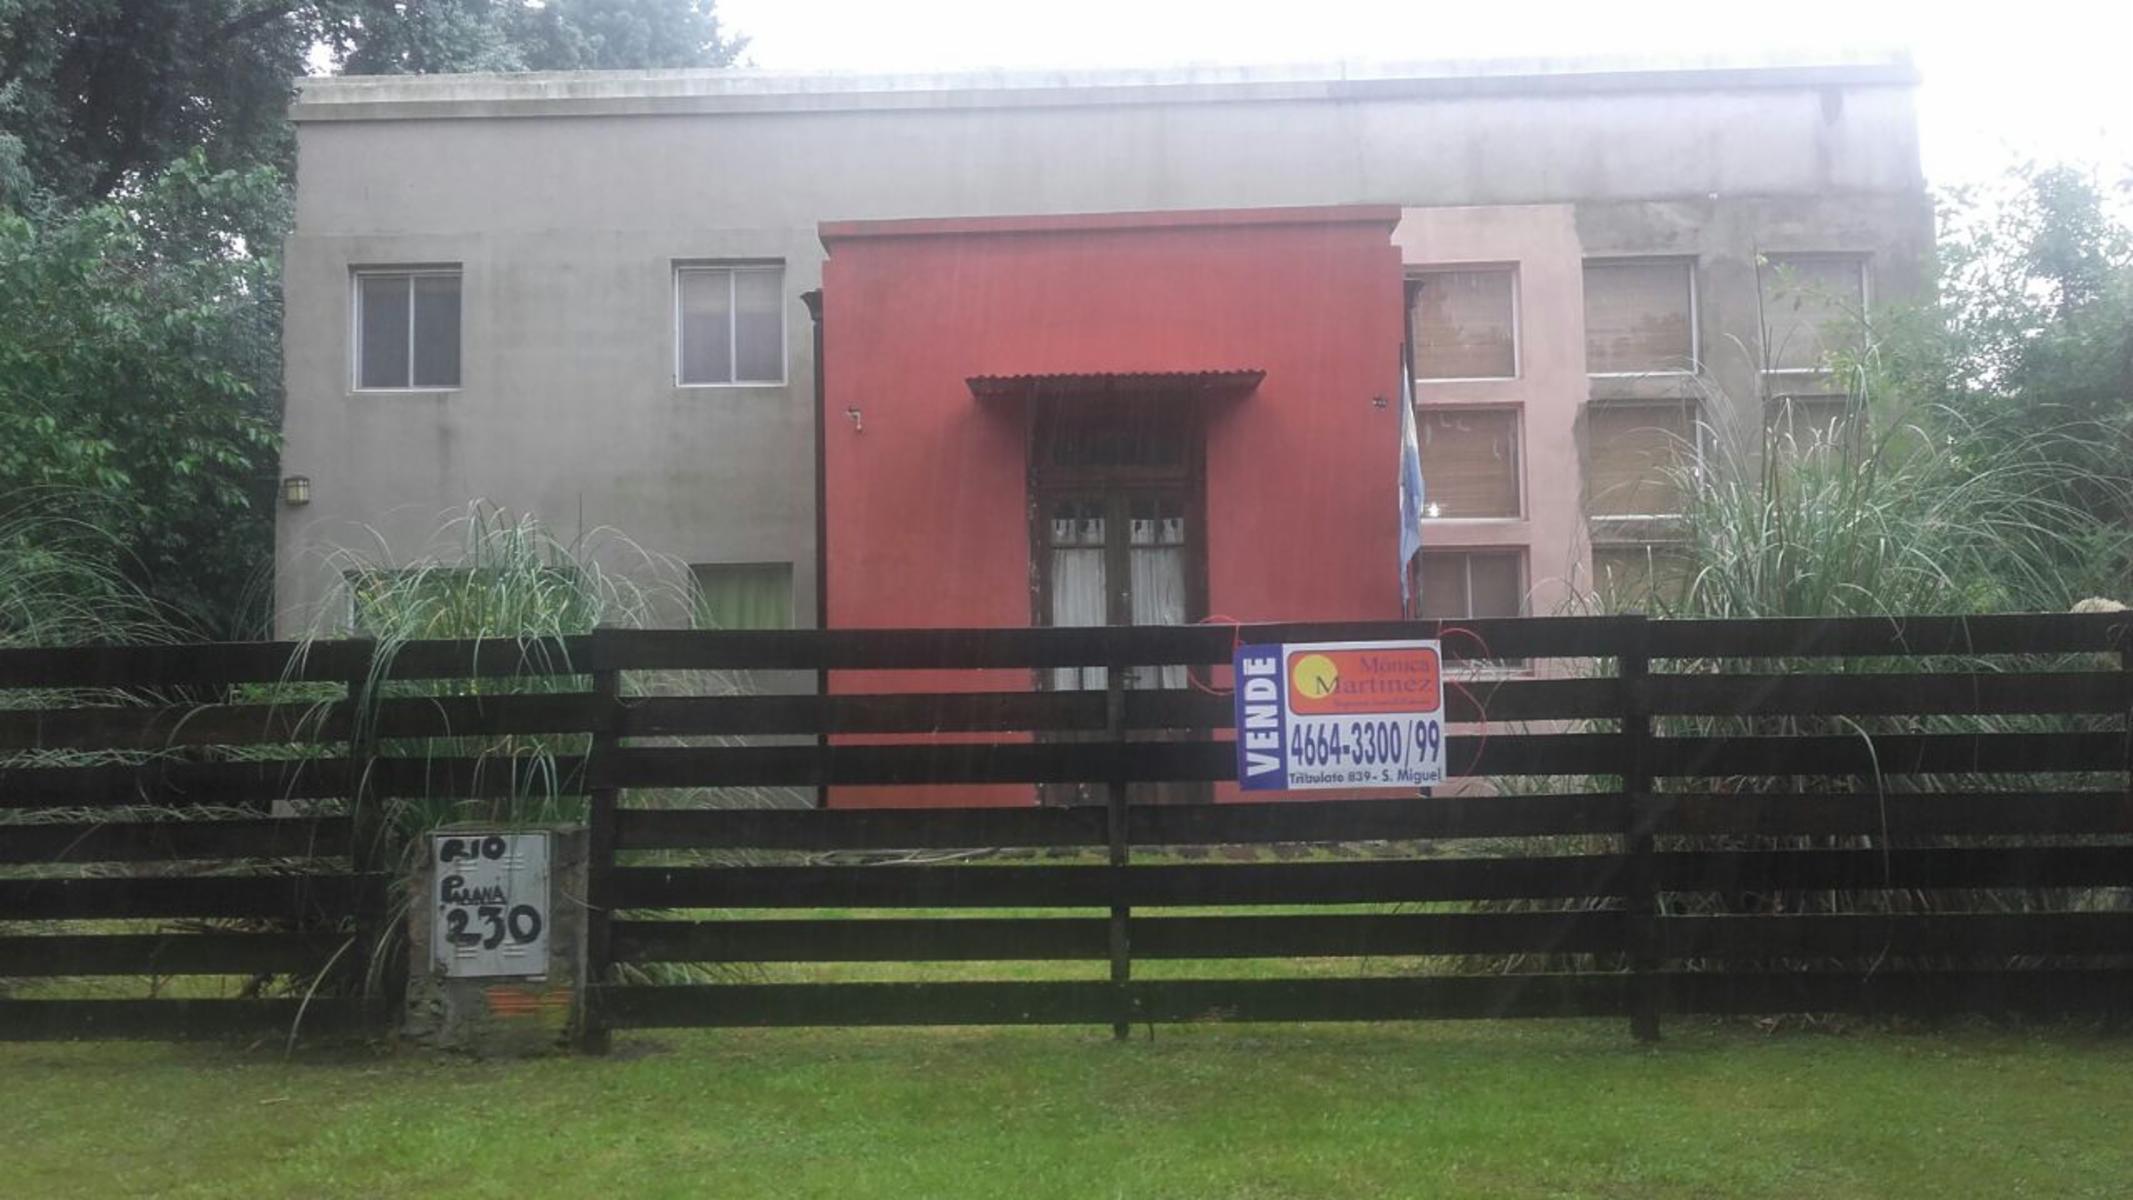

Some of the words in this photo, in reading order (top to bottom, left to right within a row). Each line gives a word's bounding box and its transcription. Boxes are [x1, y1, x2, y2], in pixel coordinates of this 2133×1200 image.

[1243, 657, 1281, 777] VENDE
[1291, 719, 1440, 768] 4664-3300/99
[1381, 769, 1394, 783] S.
[1397, 767, 1442, 785] Miguel
[440, 836, 506, 862] RIO
[446, 904, 542, 950] 230
